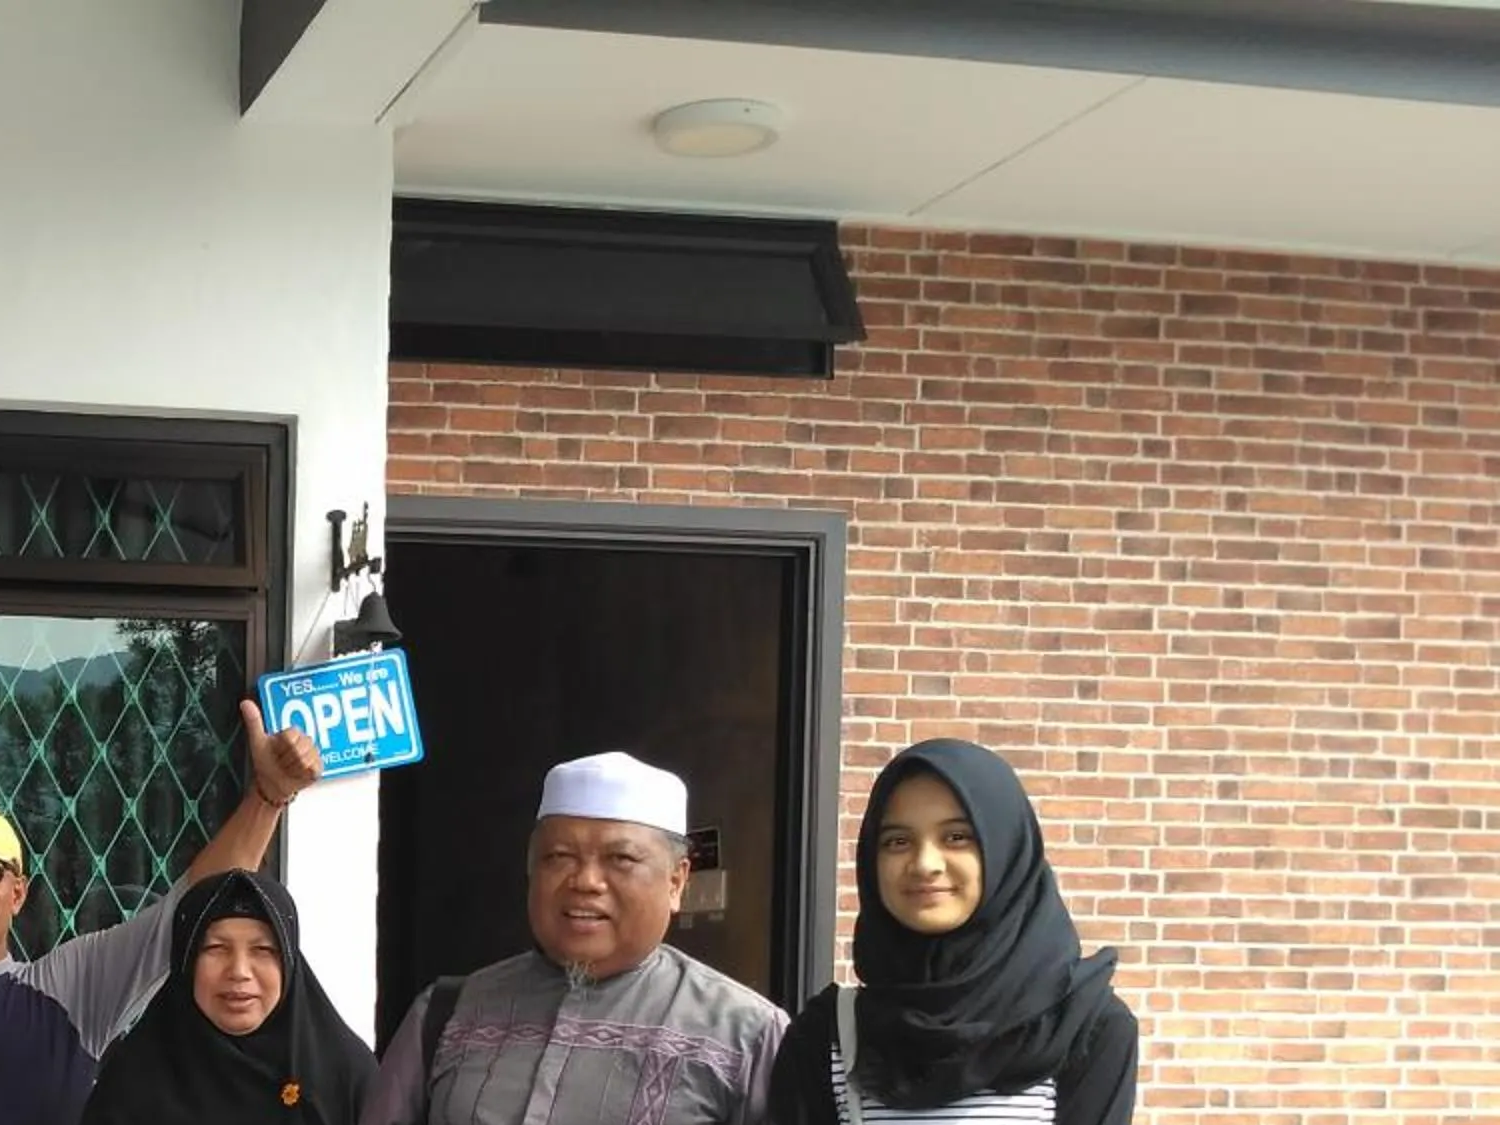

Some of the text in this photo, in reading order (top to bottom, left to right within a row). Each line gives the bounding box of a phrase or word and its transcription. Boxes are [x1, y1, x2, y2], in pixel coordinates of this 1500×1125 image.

[338, 670, 363, 687] We
[365, 667, 389, 682] are
[280, 679, 406, 750] OPEN
